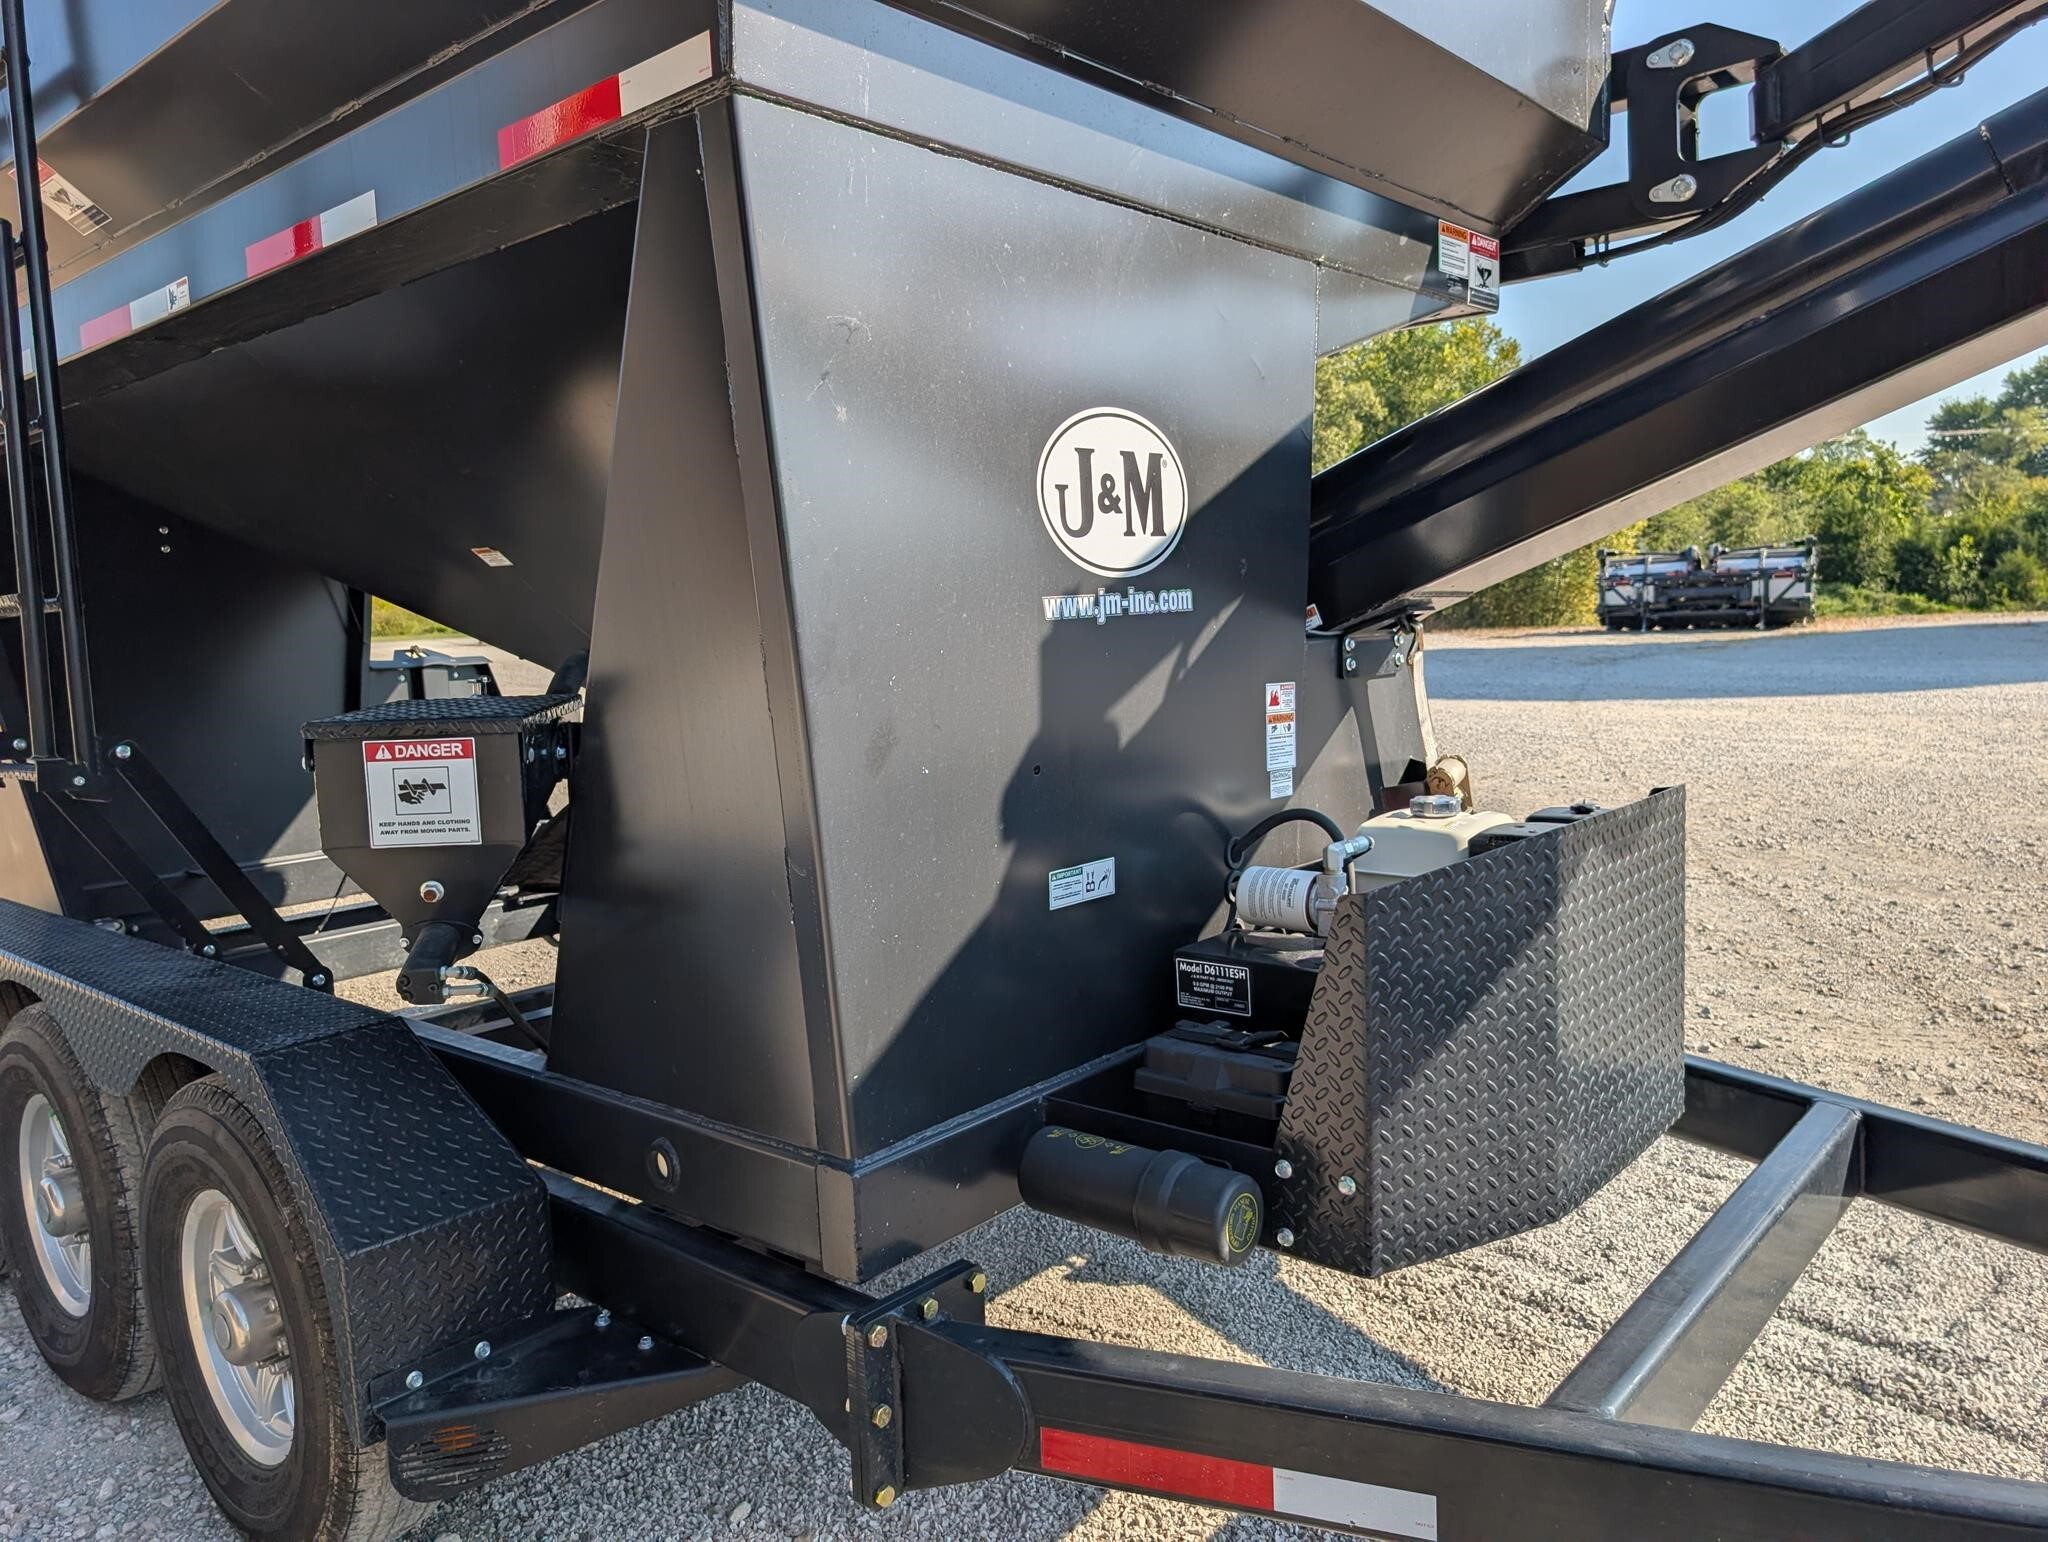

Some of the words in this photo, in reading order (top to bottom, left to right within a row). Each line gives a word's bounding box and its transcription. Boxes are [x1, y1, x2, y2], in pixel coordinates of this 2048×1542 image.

[1446, 223, 1467, 240] WARNING
[1477, 235, 1497, 252] DANGER
[1042, 586, 1193, 625] www.jm-inc.com
[394, 742, 464, 758] DANGER
[437, 818, 471, 826] CLOTHING
[1056, 867, 1083, 879] IMPORTANT
[1180, 962, 1203, 974] Model
[1204, 964, 1246, 980] D6111ESH
